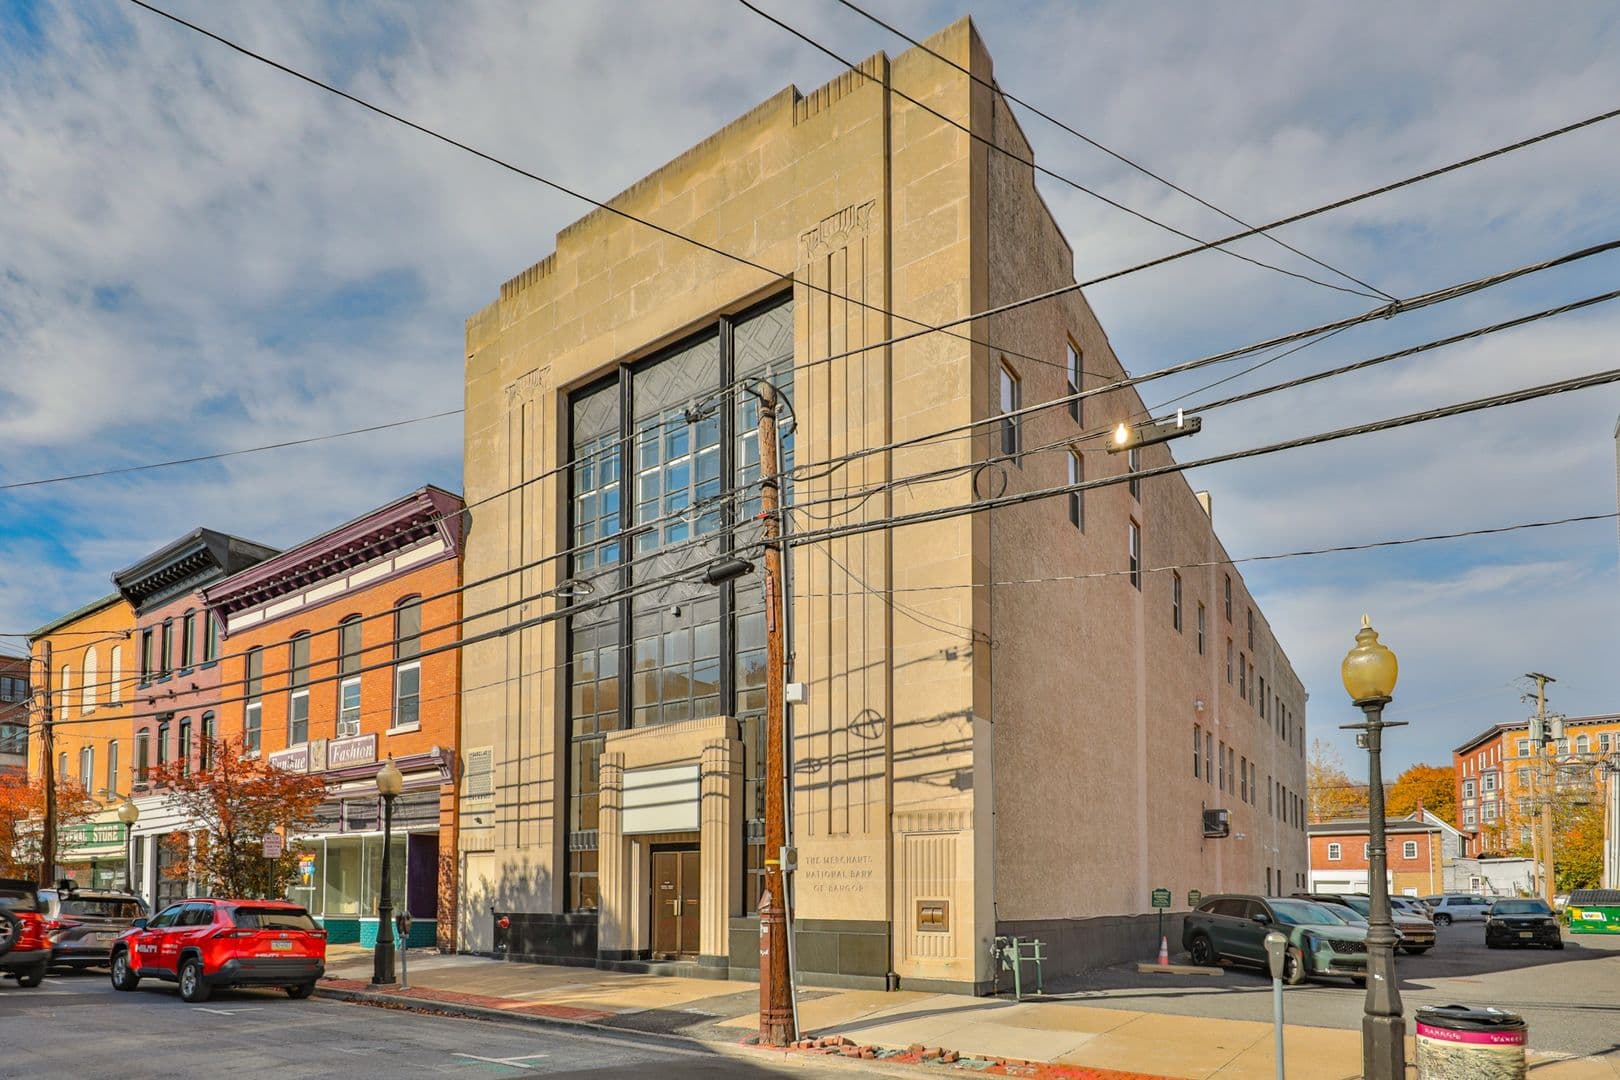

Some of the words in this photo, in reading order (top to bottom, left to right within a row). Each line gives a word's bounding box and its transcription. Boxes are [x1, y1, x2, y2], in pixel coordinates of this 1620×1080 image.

[333, 744, 373, 763] Fashion
[93, 825, 118, 842] STORE
[806, 856, 821, 865] THE
[823, 855, 873, 865] MERCHANTS
[805, 870, 848, 879] NATIONAL
[850, 869, 873, 878] BANK
[813, 884, 825, 893] OF
[828, 884, 864, 893] BANGOR
